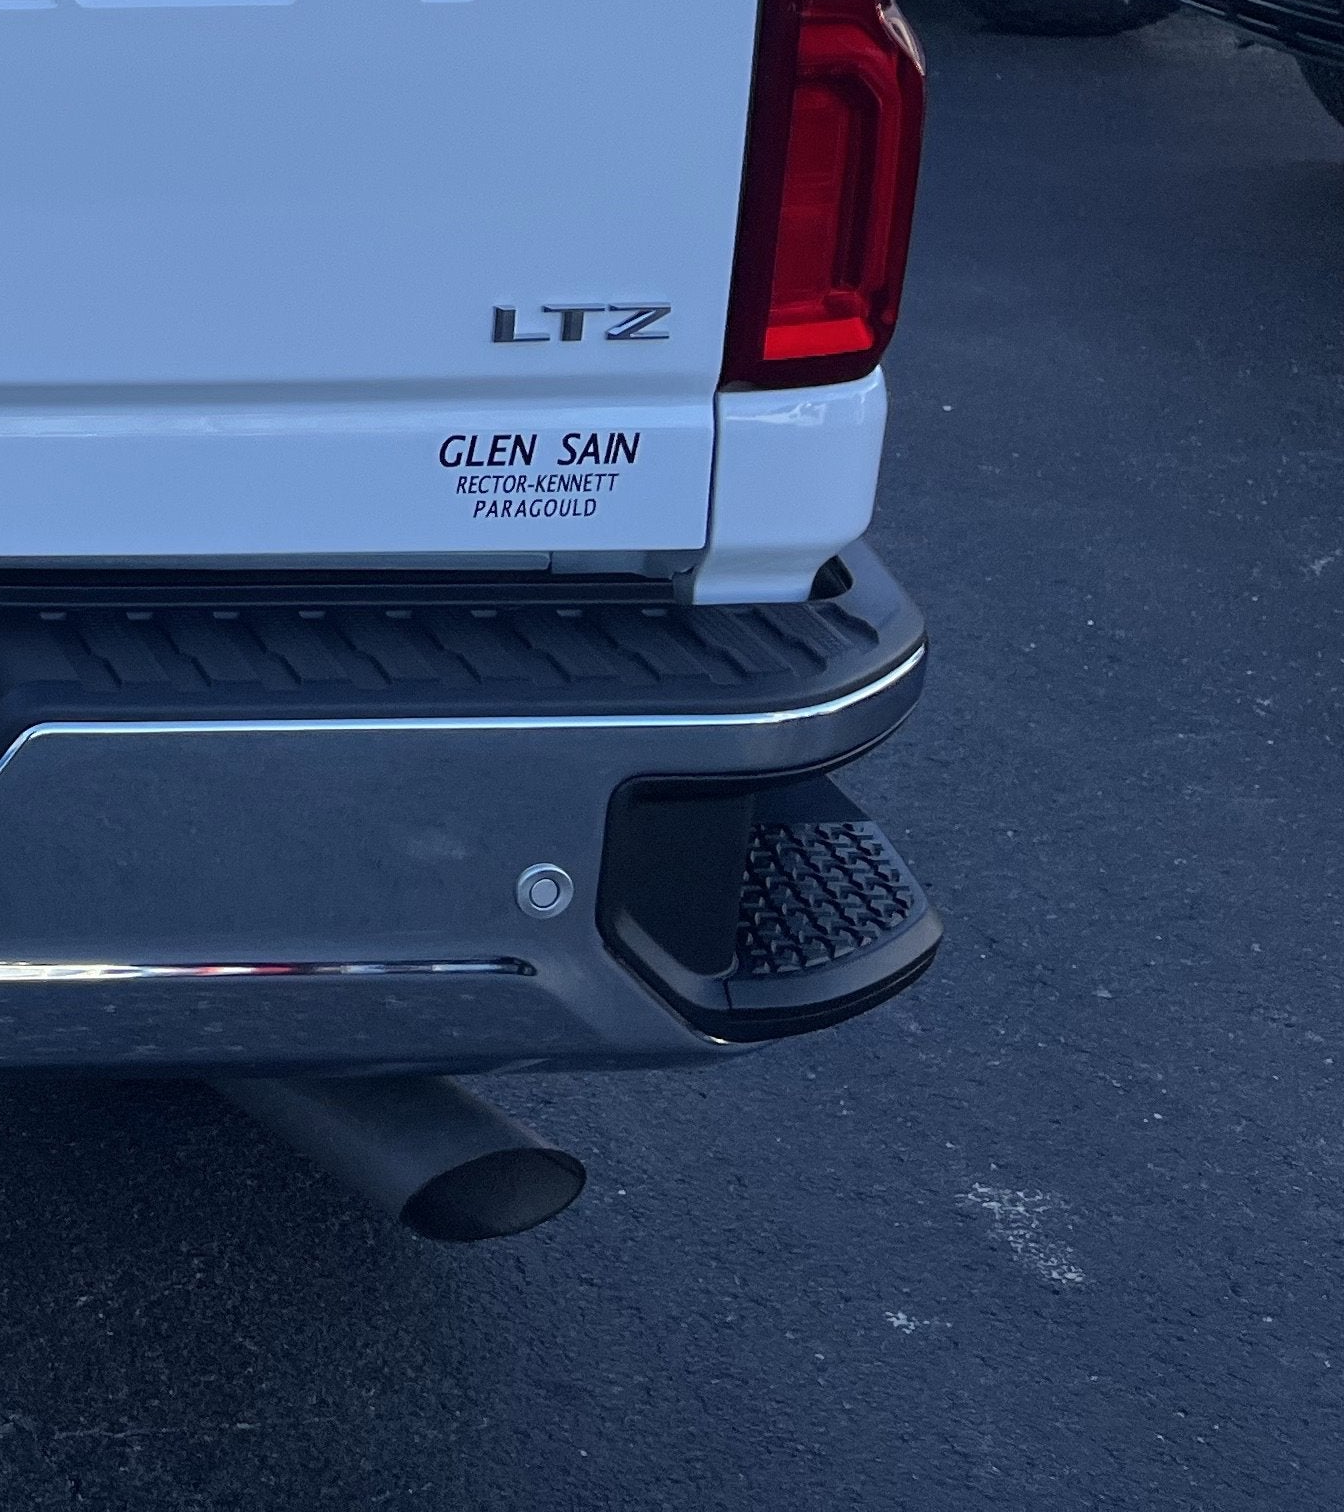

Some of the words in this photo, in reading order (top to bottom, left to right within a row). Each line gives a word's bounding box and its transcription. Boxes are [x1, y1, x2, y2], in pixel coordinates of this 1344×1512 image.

[492, 302, 672, 343] LTZ
[439, 434, 537, 468] GLEN
[557, 432, 641, 466] SAIN
[456, 473, 620, 494] RECTOR-KENNETT
[473, 498, 597, 518] PARAGOULD
